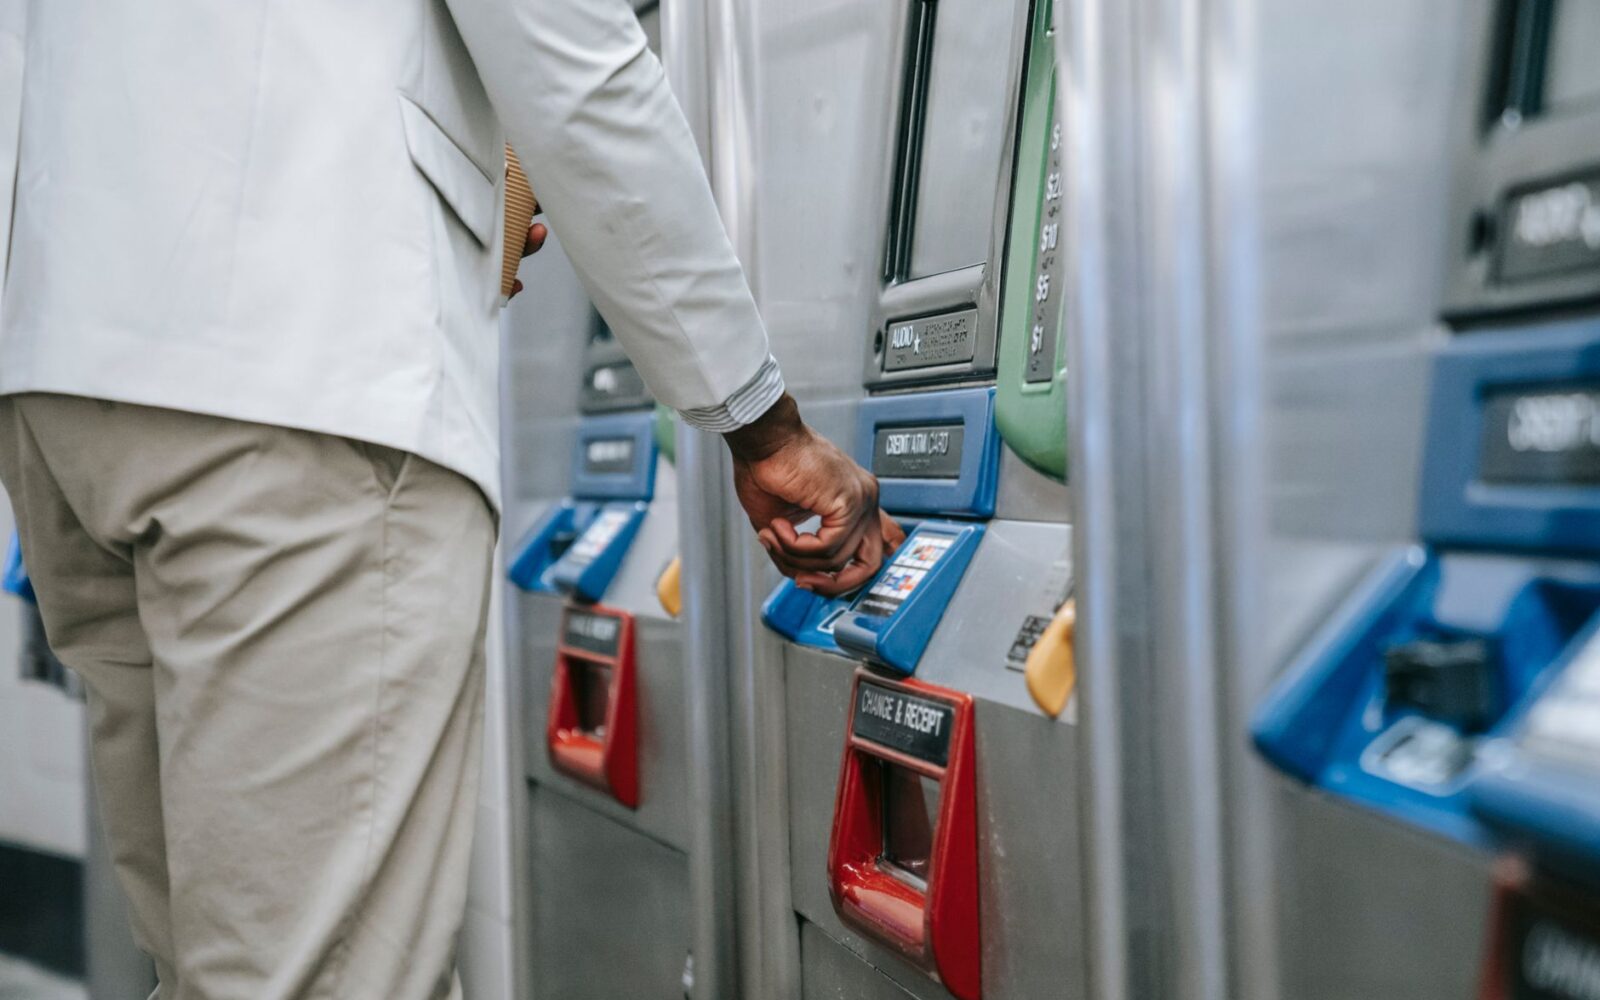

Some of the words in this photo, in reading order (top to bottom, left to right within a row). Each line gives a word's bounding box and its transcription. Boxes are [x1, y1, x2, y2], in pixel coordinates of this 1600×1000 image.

[1041, 223, 1058, 252] $10
[1036, 275, 1050, 301] $5
[1031, 324, 1044, 352] $1
[862, 689, 894, 721] CHANGE
[895, 699, 903, 724] &
[904, 702, 945, 737] RECEIPT
